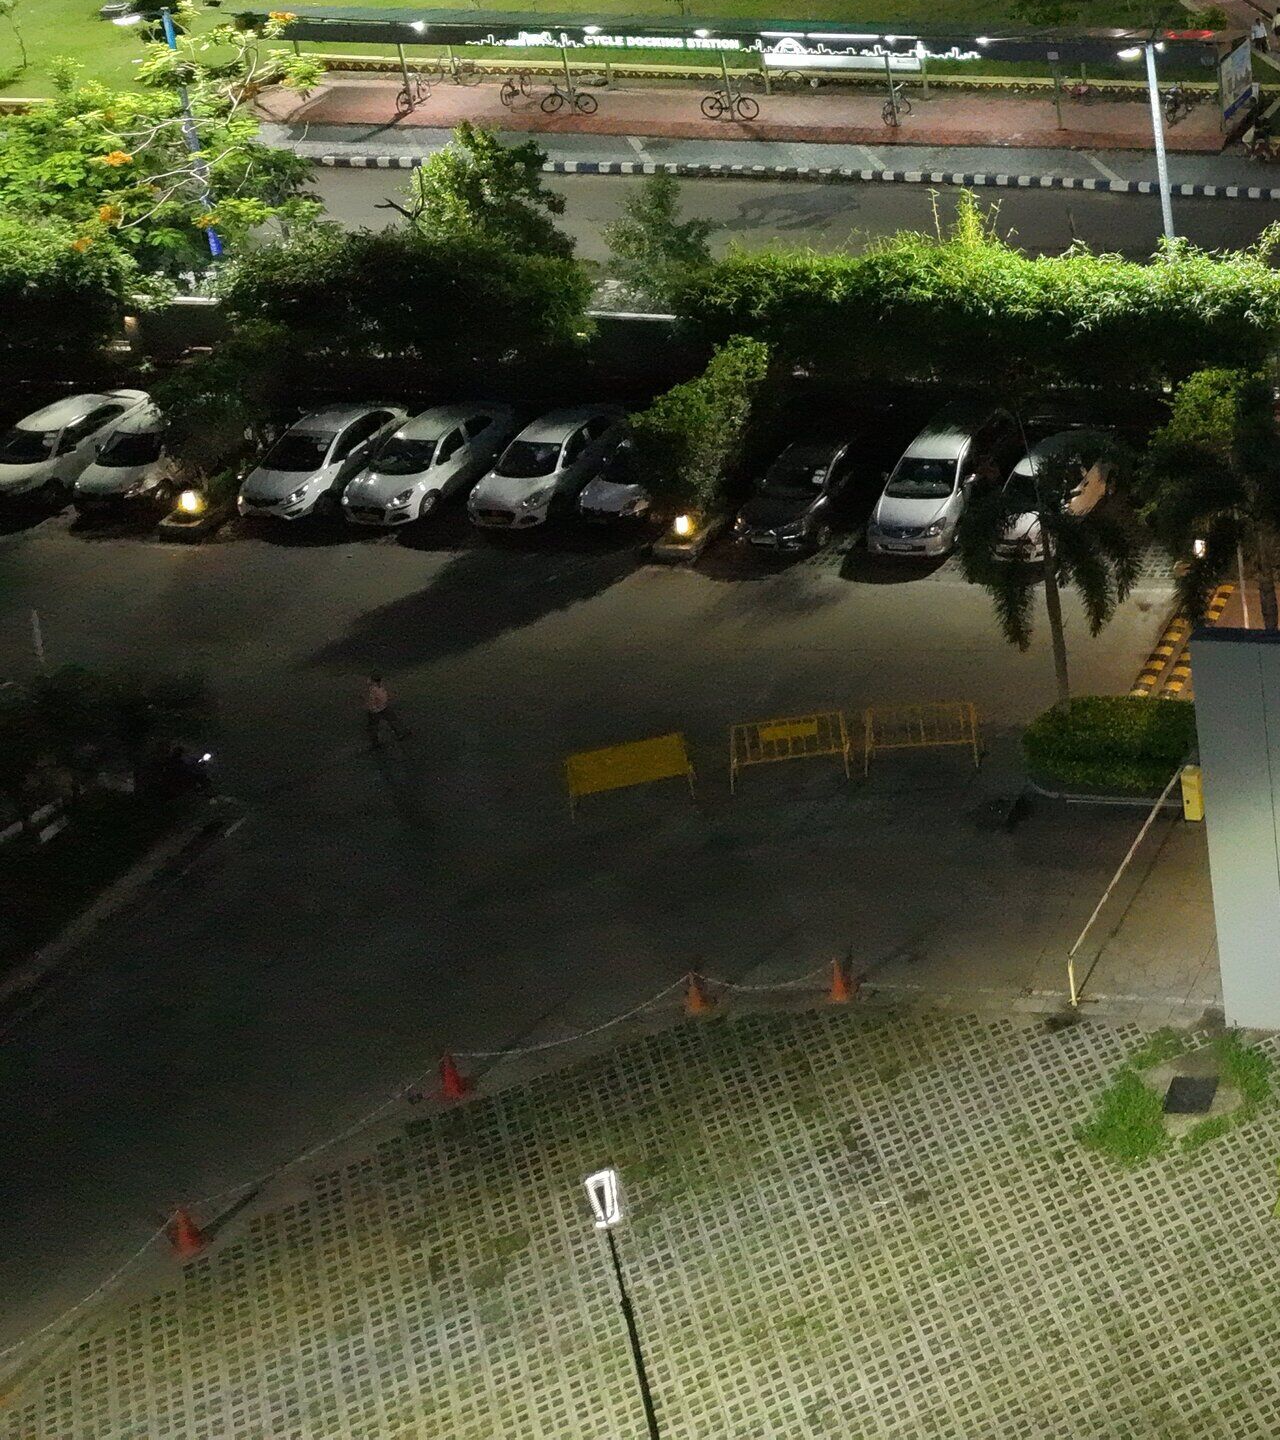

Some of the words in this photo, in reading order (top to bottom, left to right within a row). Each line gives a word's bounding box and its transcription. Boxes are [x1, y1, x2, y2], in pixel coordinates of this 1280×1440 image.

[583, 35, 624, 46] CYCLE
[626, 36, 684, 48] DOCKING
[686, 38, 740, 49] STATION
